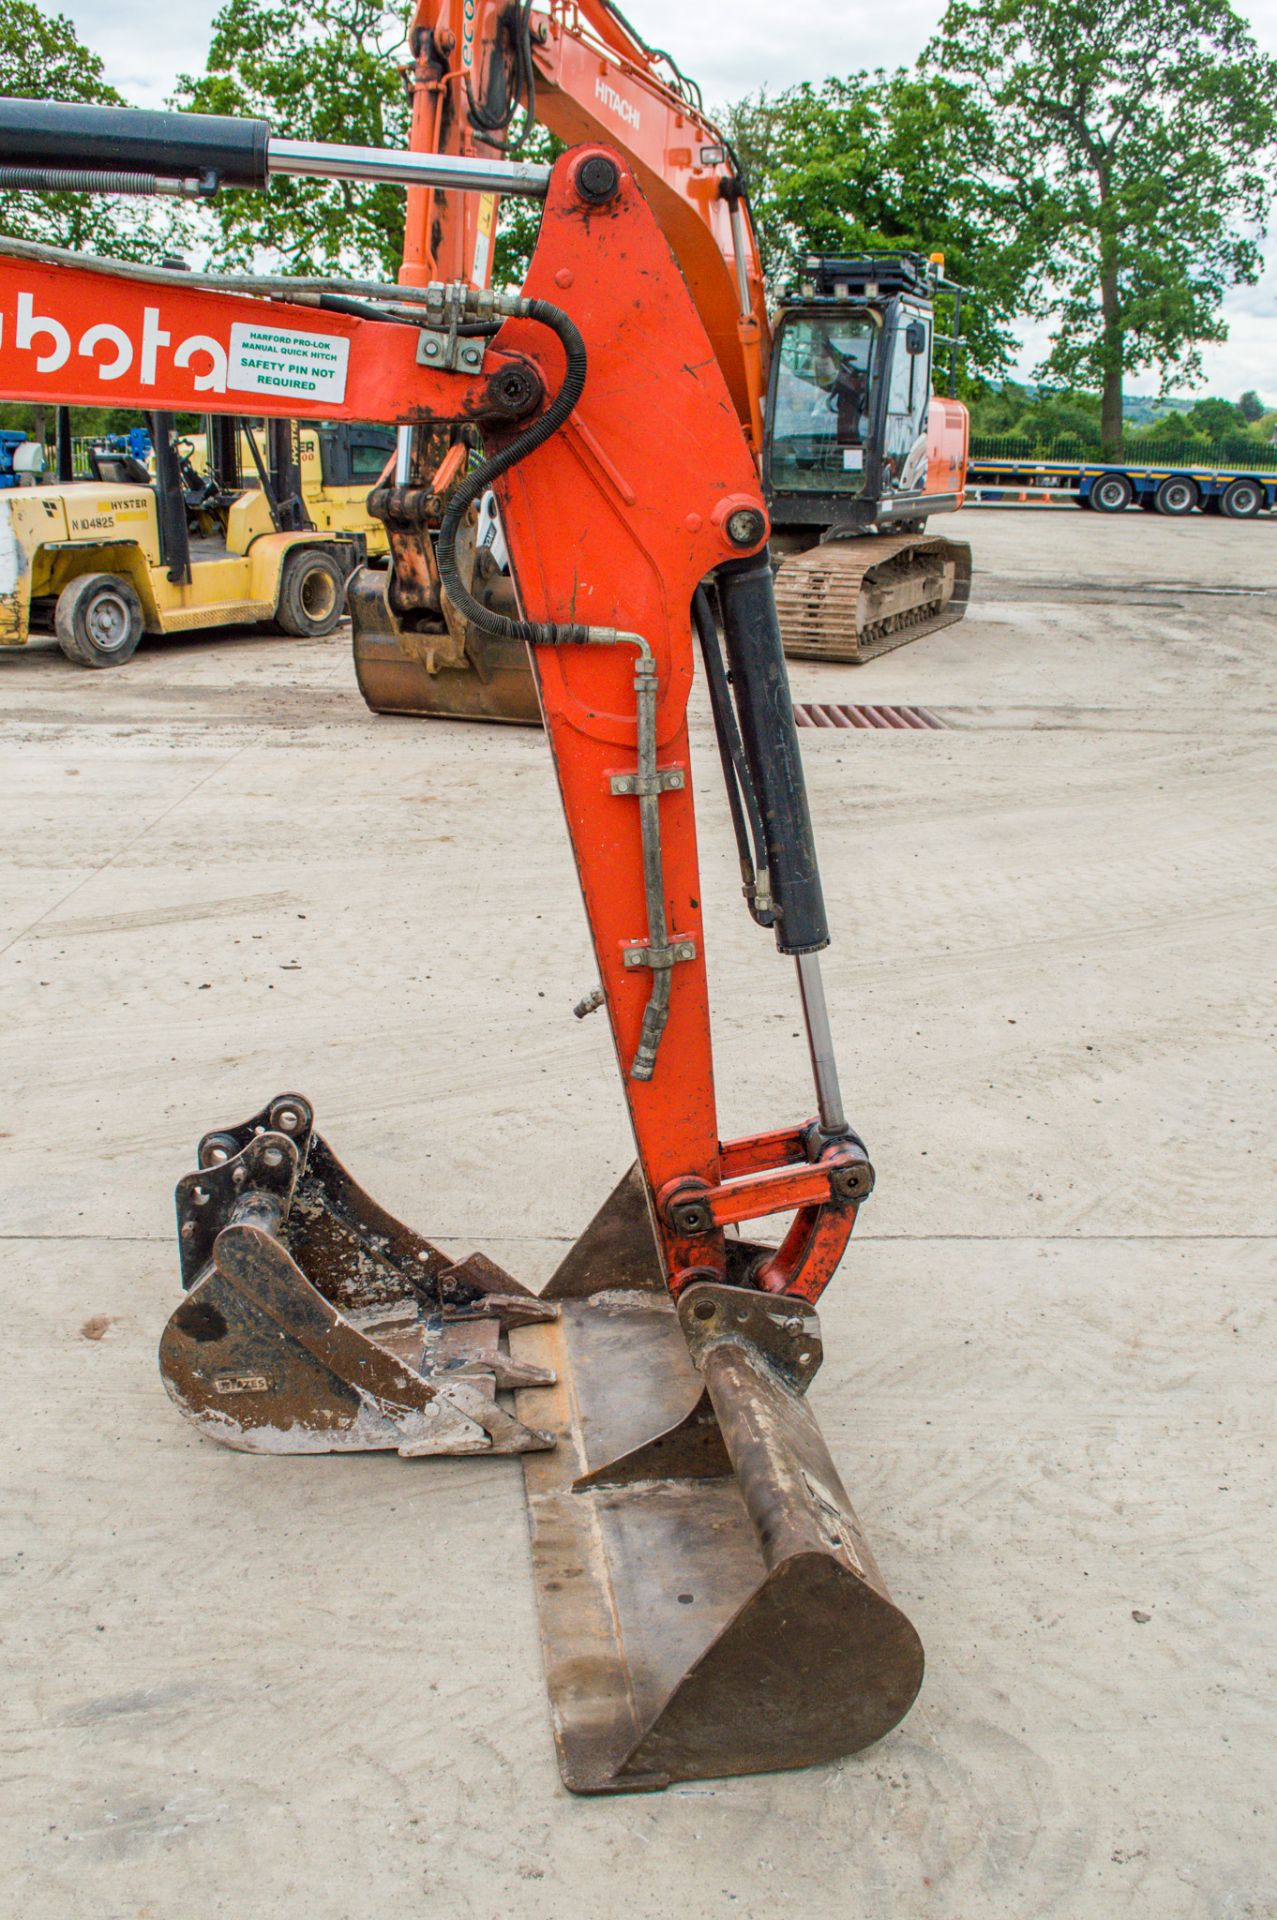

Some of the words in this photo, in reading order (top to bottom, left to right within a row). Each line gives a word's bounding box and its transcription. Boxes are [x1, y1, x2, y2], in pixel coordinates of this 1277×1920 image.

[595, 77, 640, 131] HITACHI
[0, 292, 228, 393] bota
[242, 341, 278, 353] MANUAL
[280, 347, 309, 358] QUICK
[310, 351, 337, 361] HITCH
[250, 332, 292, 344] HARFORD
[293, 339, 331, 350] PRO-LOK
[241, 357, 285, 372] SAFETY
[288, 364, 308, 375] PIN
[311, 367, 335, 379] NOT
[257, 374, 316, 391] REQUIRED
[111, 499, 147, 510] HYSTER
